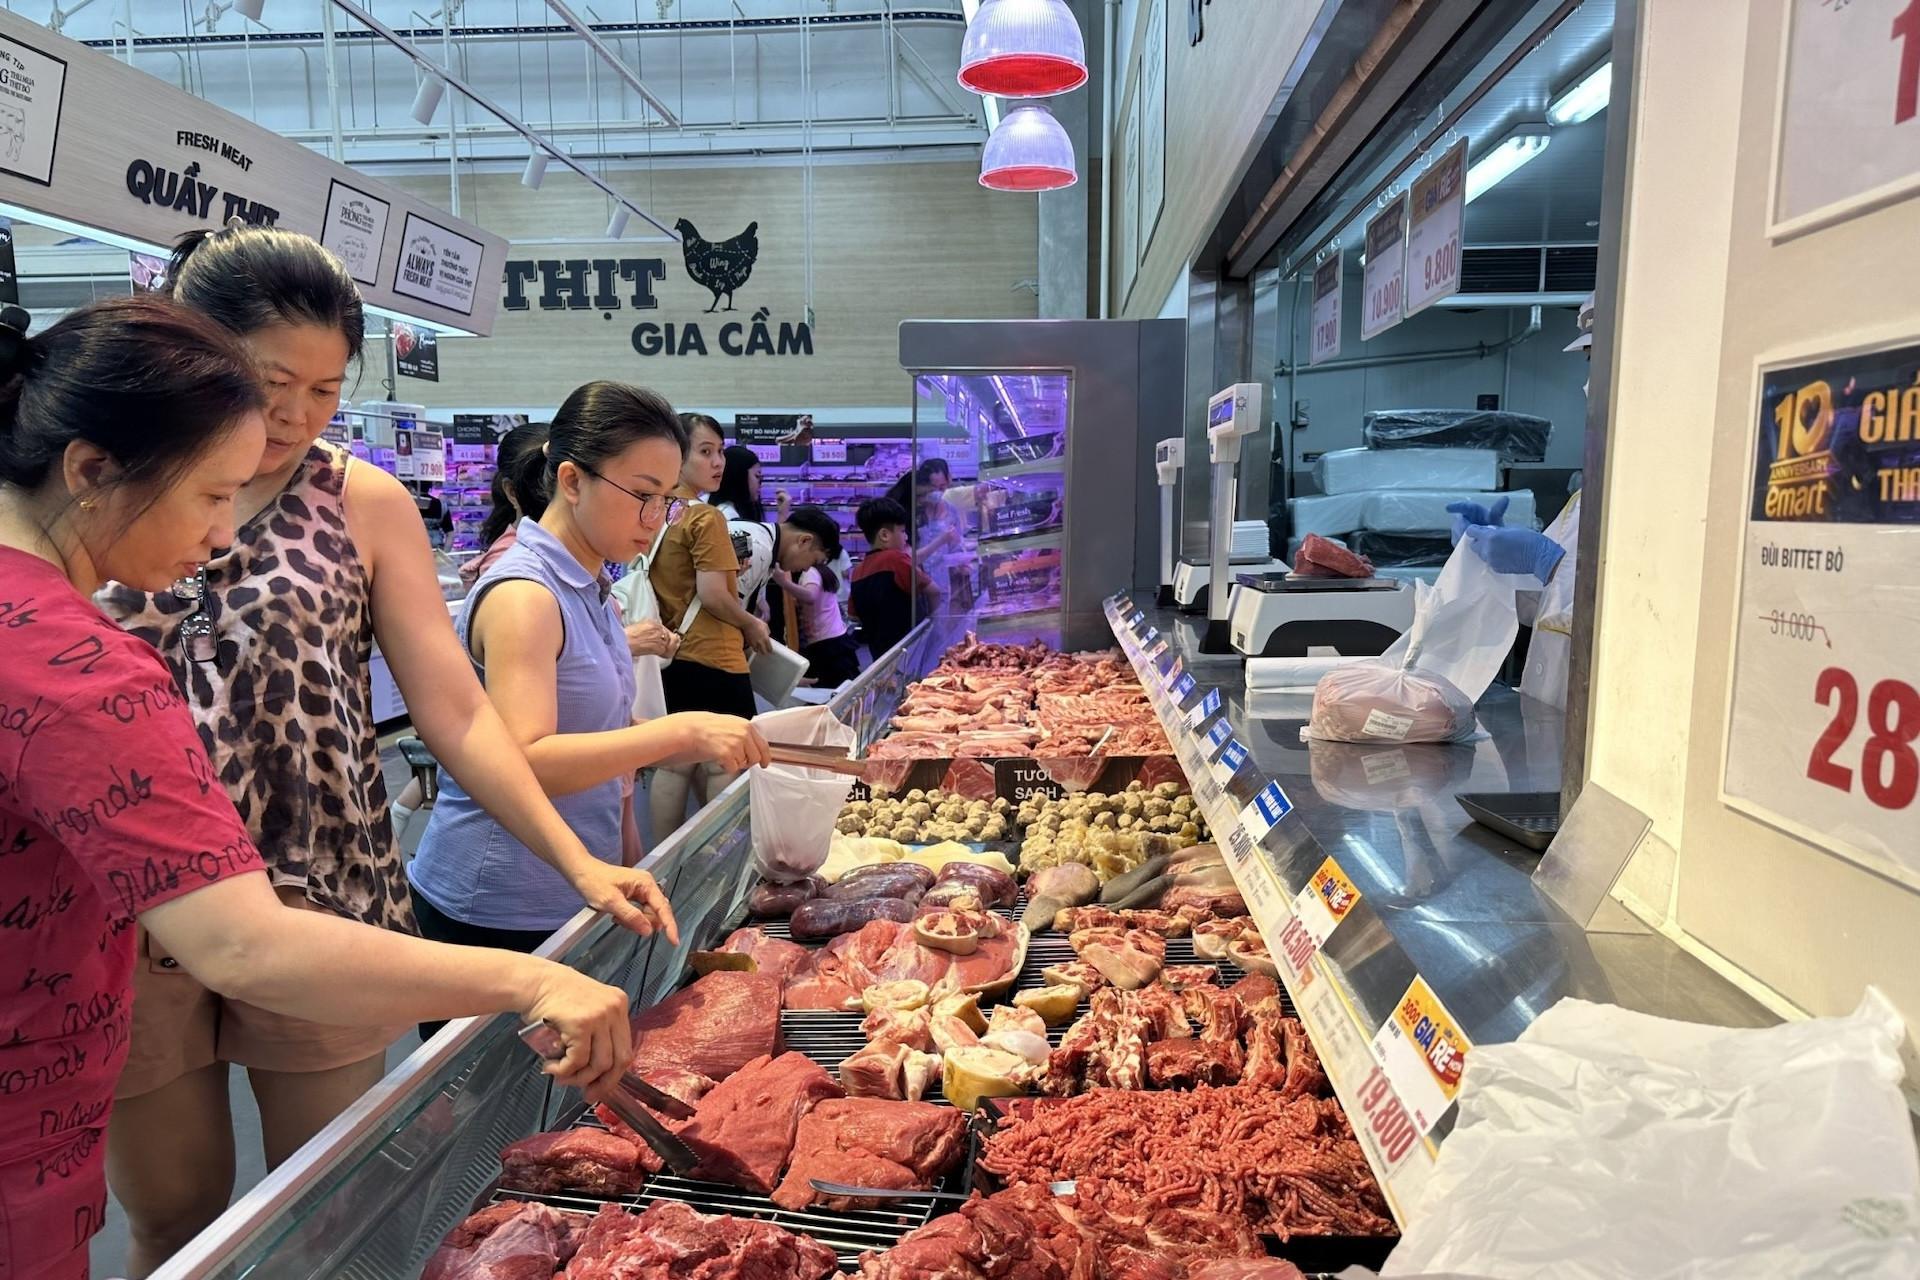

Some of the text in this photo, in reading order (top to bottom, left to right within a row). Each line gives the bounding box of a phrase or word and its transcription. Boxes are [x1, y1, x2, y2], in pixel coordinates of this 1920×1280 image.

[176, 131, 253, 172] FRESH MEAT
[126, 159, 218, 219] QUẦY
[403, 268, 432, 288] FRESH MEAT
[406, 253, 435, 277] ALWAYS
[710, 257, 729, 271] Wing
[1425, 238, 1457, 290] 9.800
[502, 258, 666, 321] THỊT
[1372, 277, 1400, 321] 10.900
[631, 306, 814, 356] GIA CẦM
[1775, 380, 1834, 461] 10
[1771, 457, 1830, 480] ANNIVERSARY
[996, 512, 1009, 520] Just
[1765, 480, 1827, 518] emart
[1762, 542, 1844, 572] ĐÙI BITTET BÒ
[1771, 609, 1815, 641] 31.000
[1807, 667, 1920, 810] 28
[1279, 914, 1317, 971] 18.500
[1402, 998, 1421, 1025] 3000
[1413, 1016, 1440, 1054] GIÁ
[1356, 1064, 1417, 1163] 19.800
